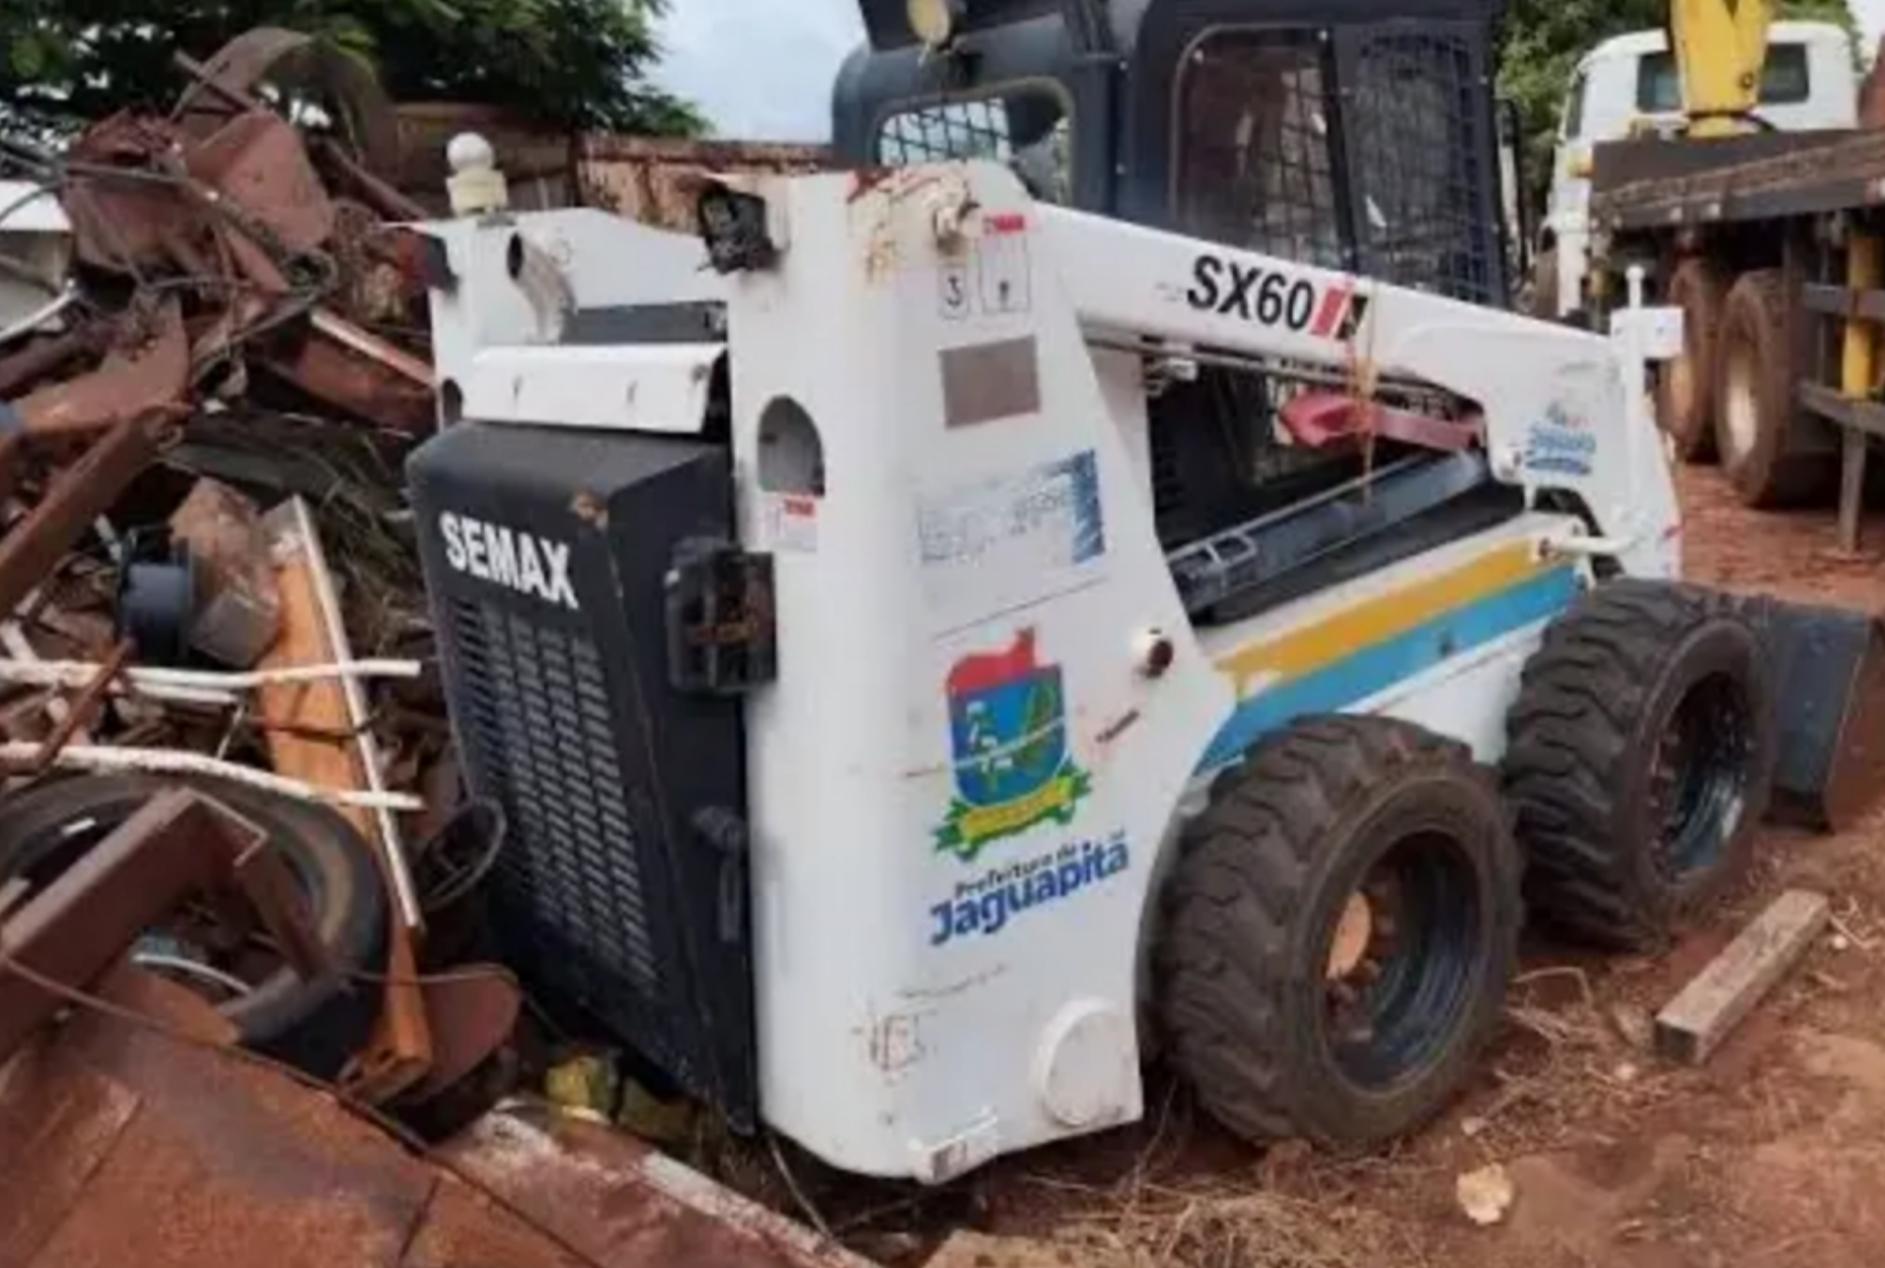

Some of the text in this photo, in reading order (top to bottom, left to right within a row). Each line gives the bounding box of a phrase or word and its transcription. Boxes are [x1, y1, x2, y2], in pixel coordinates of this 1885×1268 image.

[1187, 255, 1315, 331] SX60
[440, 510, 580, 610] SEMAX
[929, 829, 1129, 946] Jaguapitã
